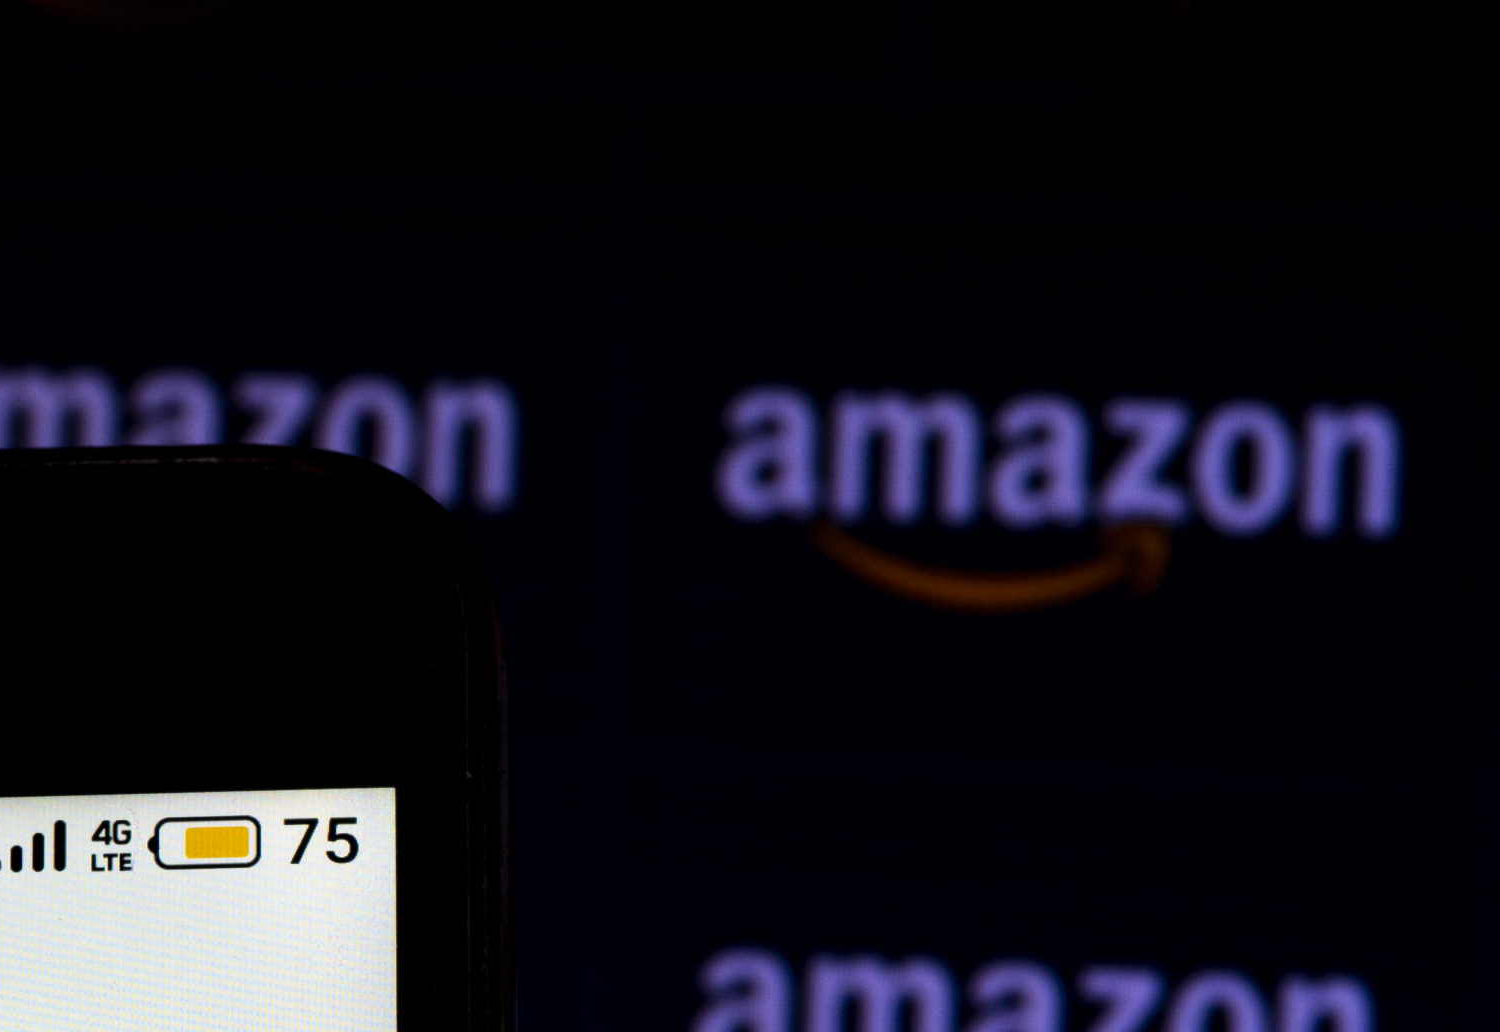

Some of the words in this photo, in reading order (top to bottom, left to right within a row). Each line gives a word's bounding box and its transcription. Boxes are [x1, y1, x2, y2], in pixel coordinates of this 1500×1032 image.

[715, 386, 1404, 539] amazon
[91, 819, 132, 846] 4G
[283, 817, 359, 865] 75
[91, 852, 132, 872] LTE
